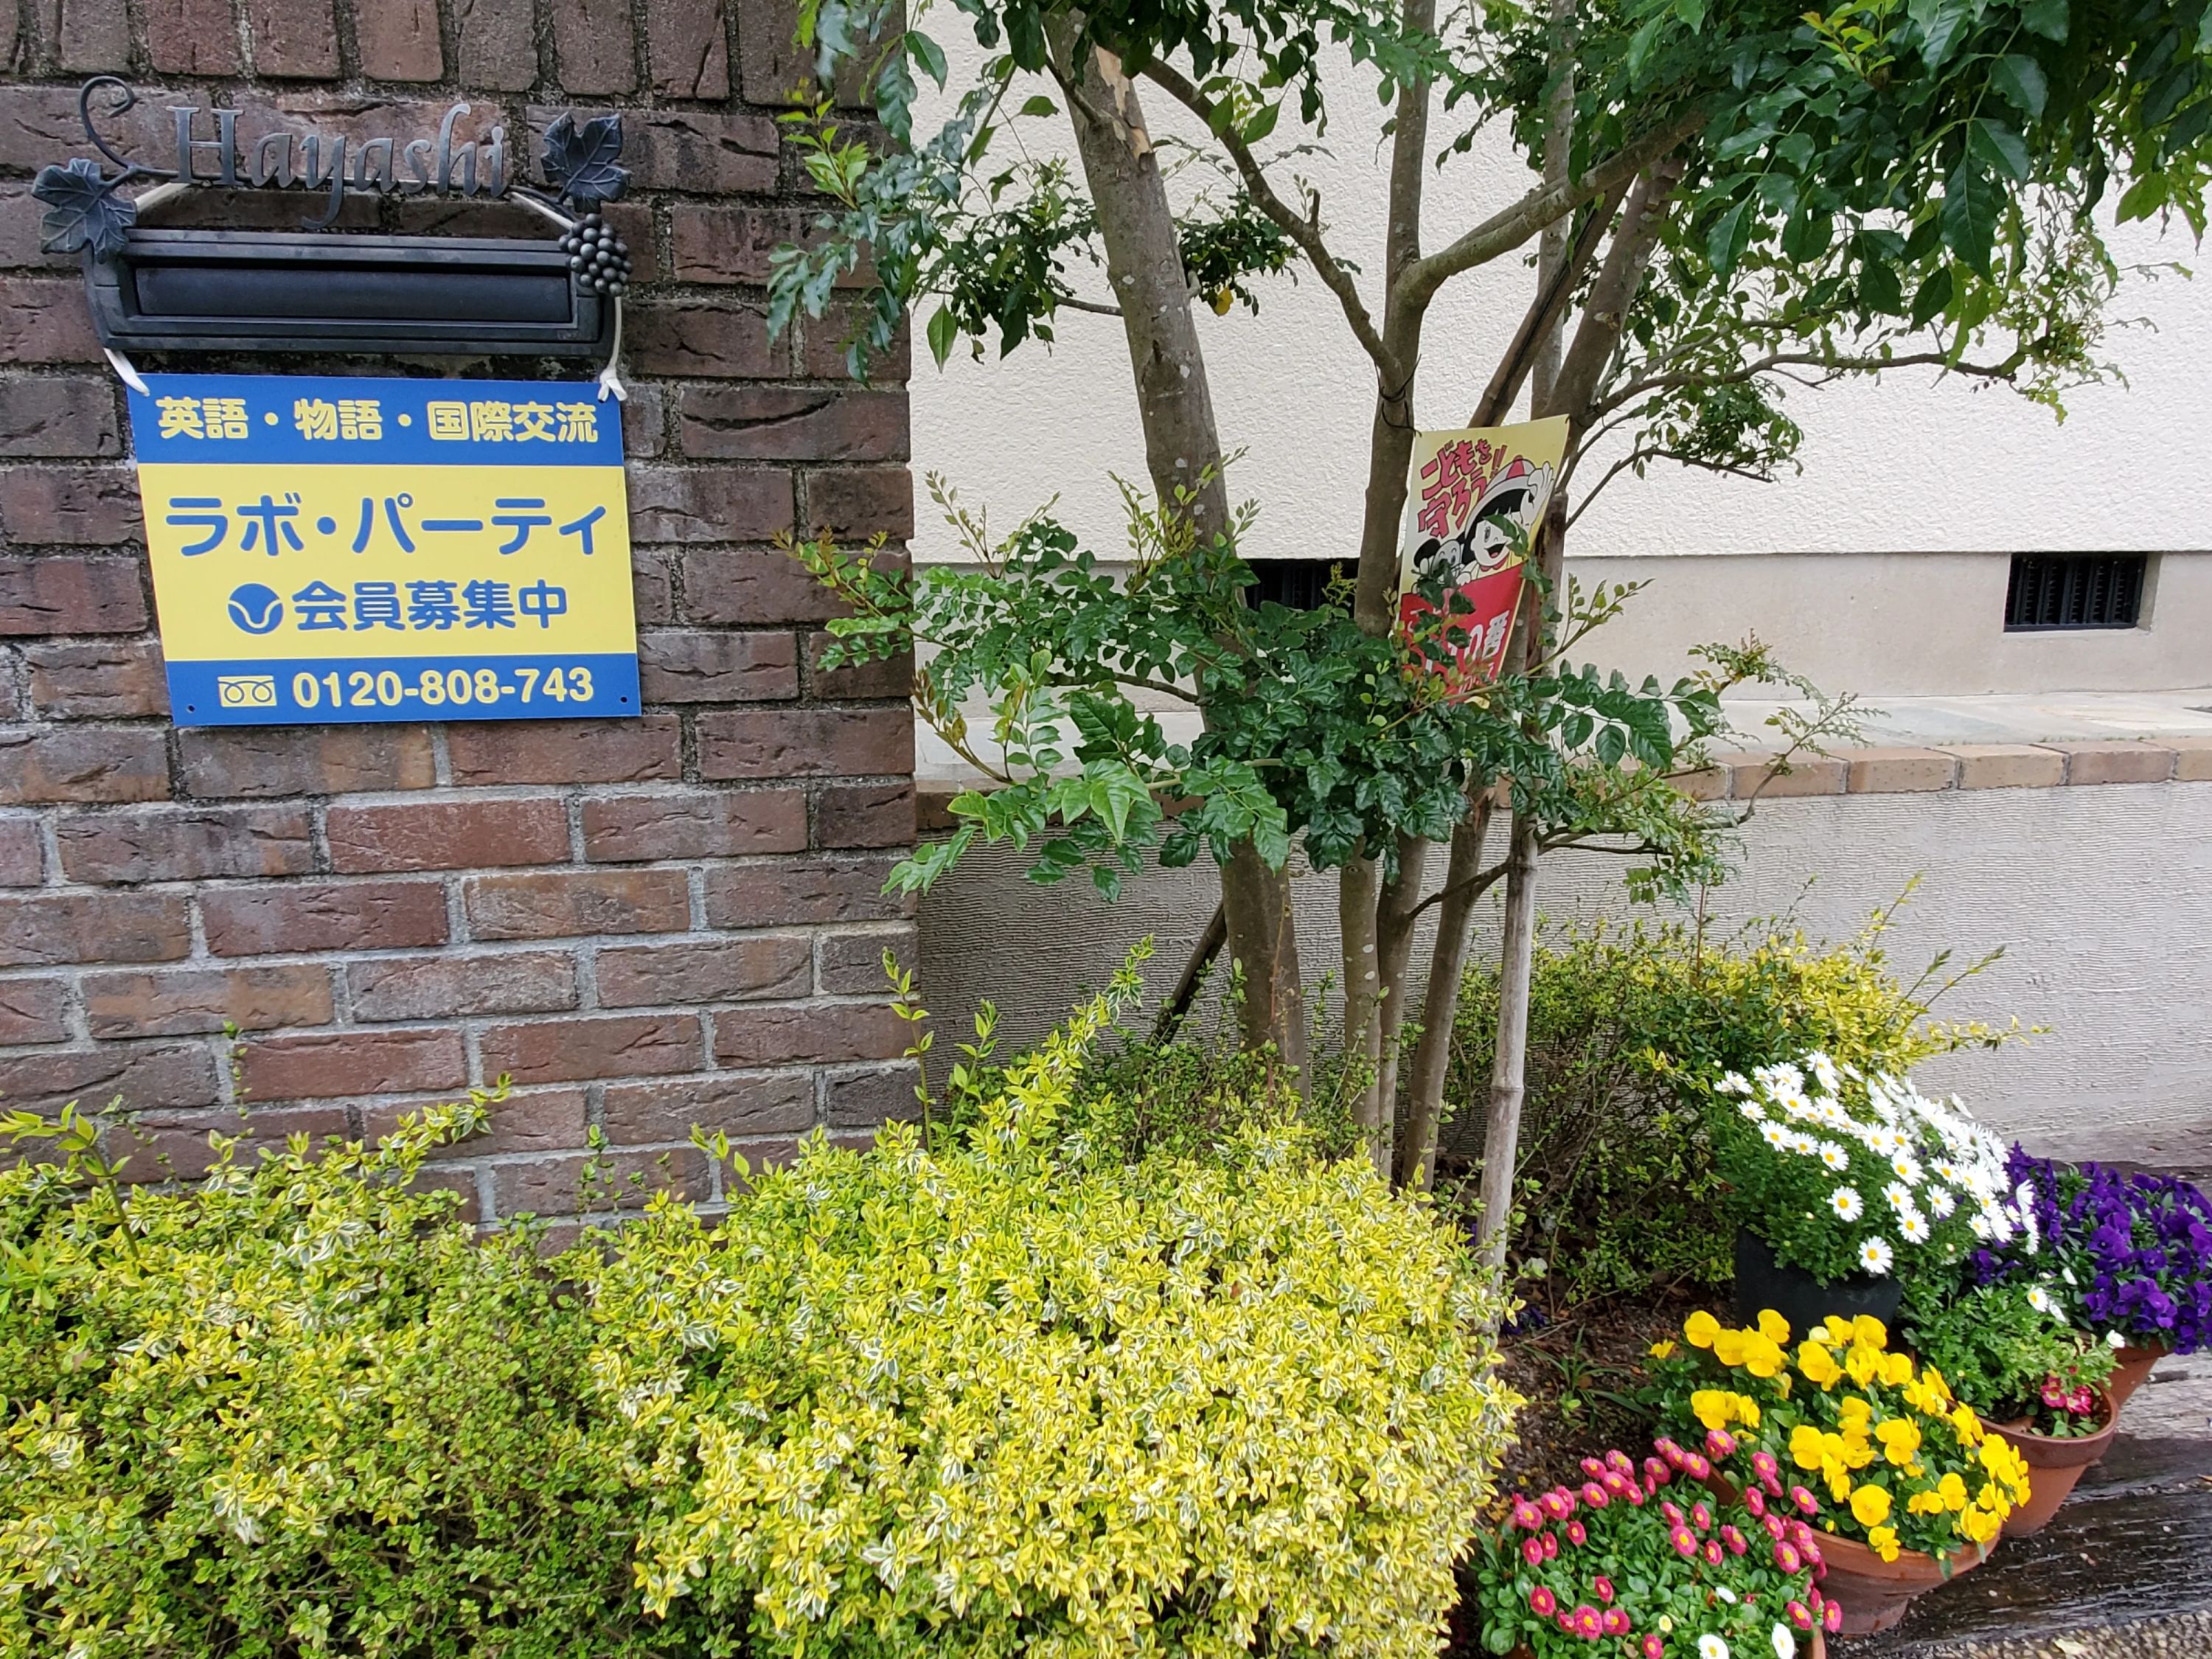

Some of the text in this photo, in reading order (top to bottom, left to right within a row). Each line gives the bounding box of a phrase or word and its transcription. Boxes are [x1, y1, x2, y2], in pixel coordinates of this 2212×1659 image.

[166, 103, 507, 229] Hayashi
[156, 397, 598, 442] 英語・物語・国際交流
[1420, 438, 1492, 501] こどもを
[165, 492, 606, 556] ラボ・パーティ
[292, 580, 567, 631] 会員募集中
[293, 667, 594, 708] 0120-808-743
